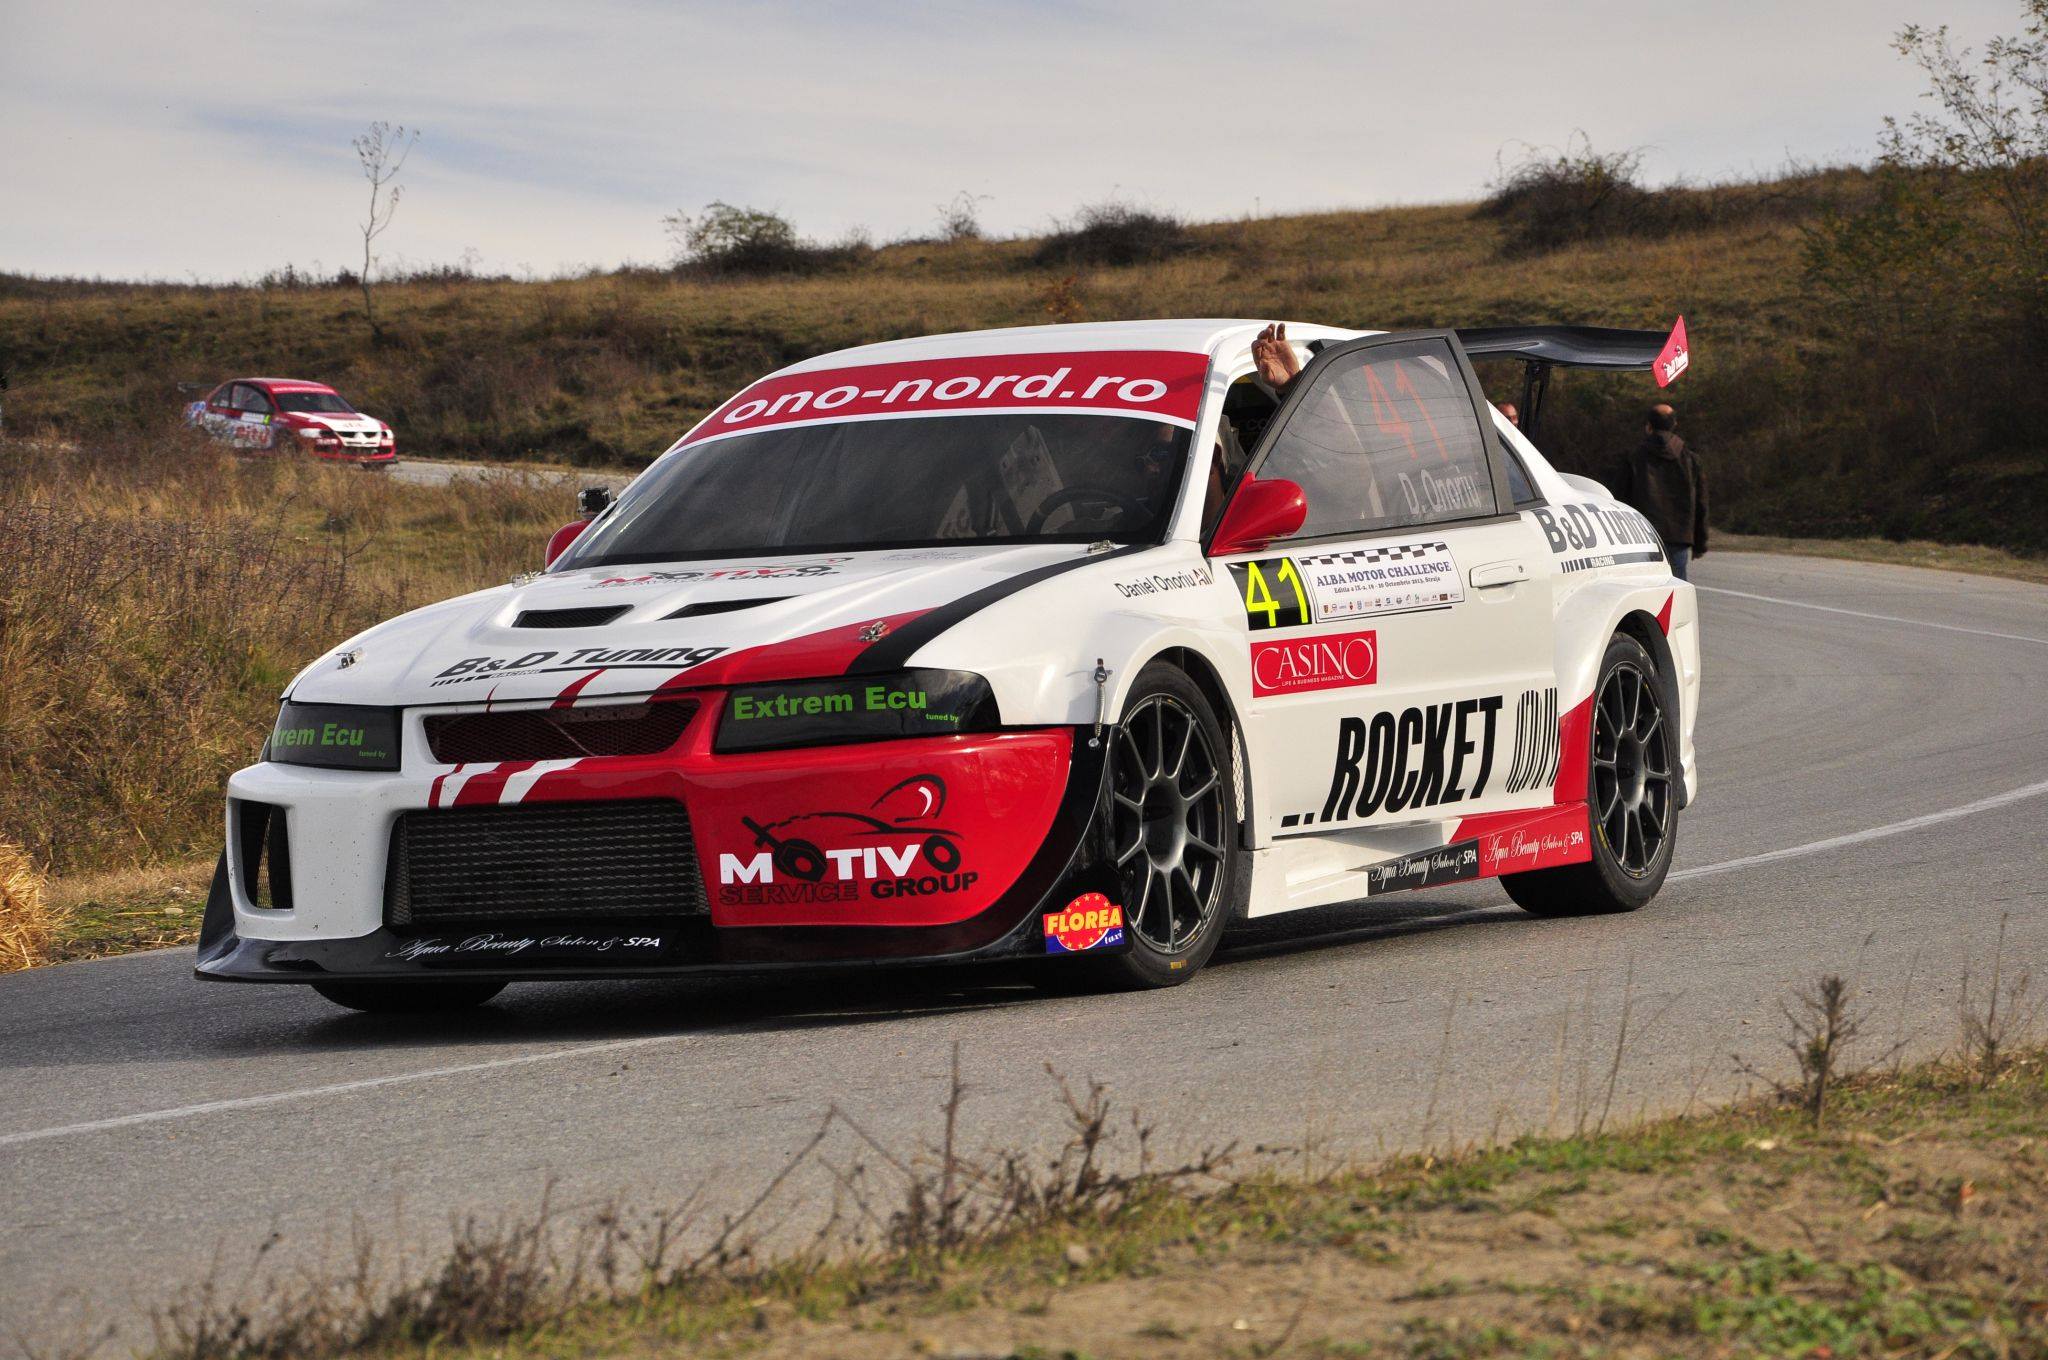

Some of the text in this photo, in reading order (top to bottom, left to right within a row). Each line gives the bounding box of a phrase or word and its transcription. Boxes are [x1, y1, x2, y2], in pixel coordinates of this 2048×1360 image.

[723, 367, 1168, 424] ono-nord.ro
[1362, 360, 1448, 462] 41
[1530, 503, 1597, 554] B&D
[1317, 561, 1451, 587] ALBA MOTOR CHALLENGE
[1591, 556, 1616, 568] RACING
[1114, 576, 1159, 598] Daniel
[1153, 571, 1197, 590] Onoriu
[1246, 556, 1309, 627] 41
[435, 647, 731, 679] B&D Tuning
[1254, 638, 1374, 690] CASINO
[1321, 674, 1345, 682] MAGAZINE
[734, 686, 927, 720] Extrem Ecu
[926, 713, 959, 723] tuned by
[321, 723, 365, 746] Ecu
[1510, 829, 1540, 865] Beauty
[1570, 830, 1584, 846] SPA
[1399, 857, 1431, 885] Beauty
[1463, 849, 1478, 865] SPA
[720, 871, 979, 905] SERVICE GROUP
[1047, 908, 1121, 934] FLOREA
[1105, 929, 1122, 944] taxi
[453, 932, 536, 956] Beauty
[540, 934, 600, 948] Salon
[622, 936, 661, 948] SPA
